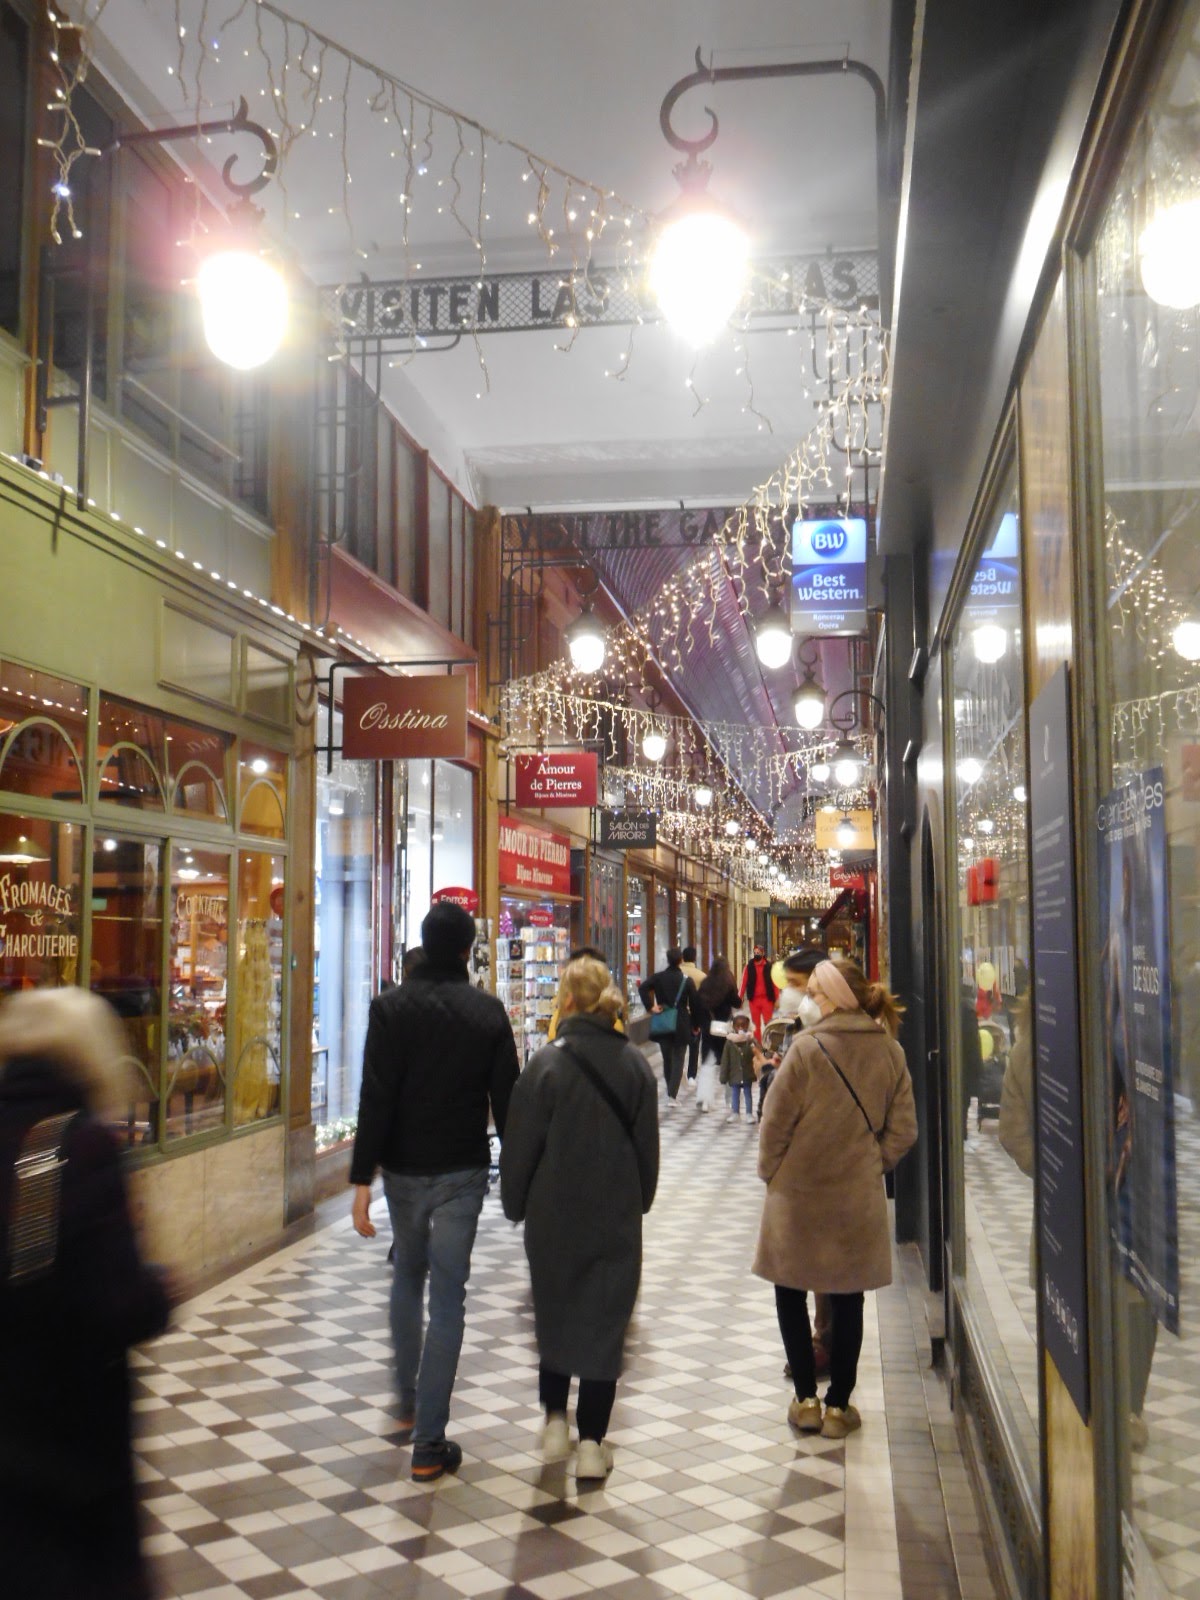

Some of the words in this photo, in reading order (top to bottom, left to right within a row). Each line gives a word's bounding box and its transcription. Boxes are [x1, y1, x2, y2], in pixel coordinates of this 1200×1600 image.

[339, 282, 499, 331] VISITEN
[531, 274, 608, 319] LAS
[518, 515, 590, 547] VISIT
[606, 513, 661, 546] THE
[815, 530, 844, 549] BW
[812, 573, 846, 587] Best
[798, 586, 859, 601] Western
[359, 701, 448, 731] Osstina
[537, 763, 576, 775] Amour
[530, 779, 543, 791] de
[546, 779, 582, 791] Pierres
[609, 821, 638, 831] SALON
[608, 831, 647, 840] MIROIRS
[498, 826, 527, 856] AMOUR
[528, 835, 539, 859] DE
[540, 839, 567, 867] PIERRES
[0, 873, 72, 916] FROMAGES
